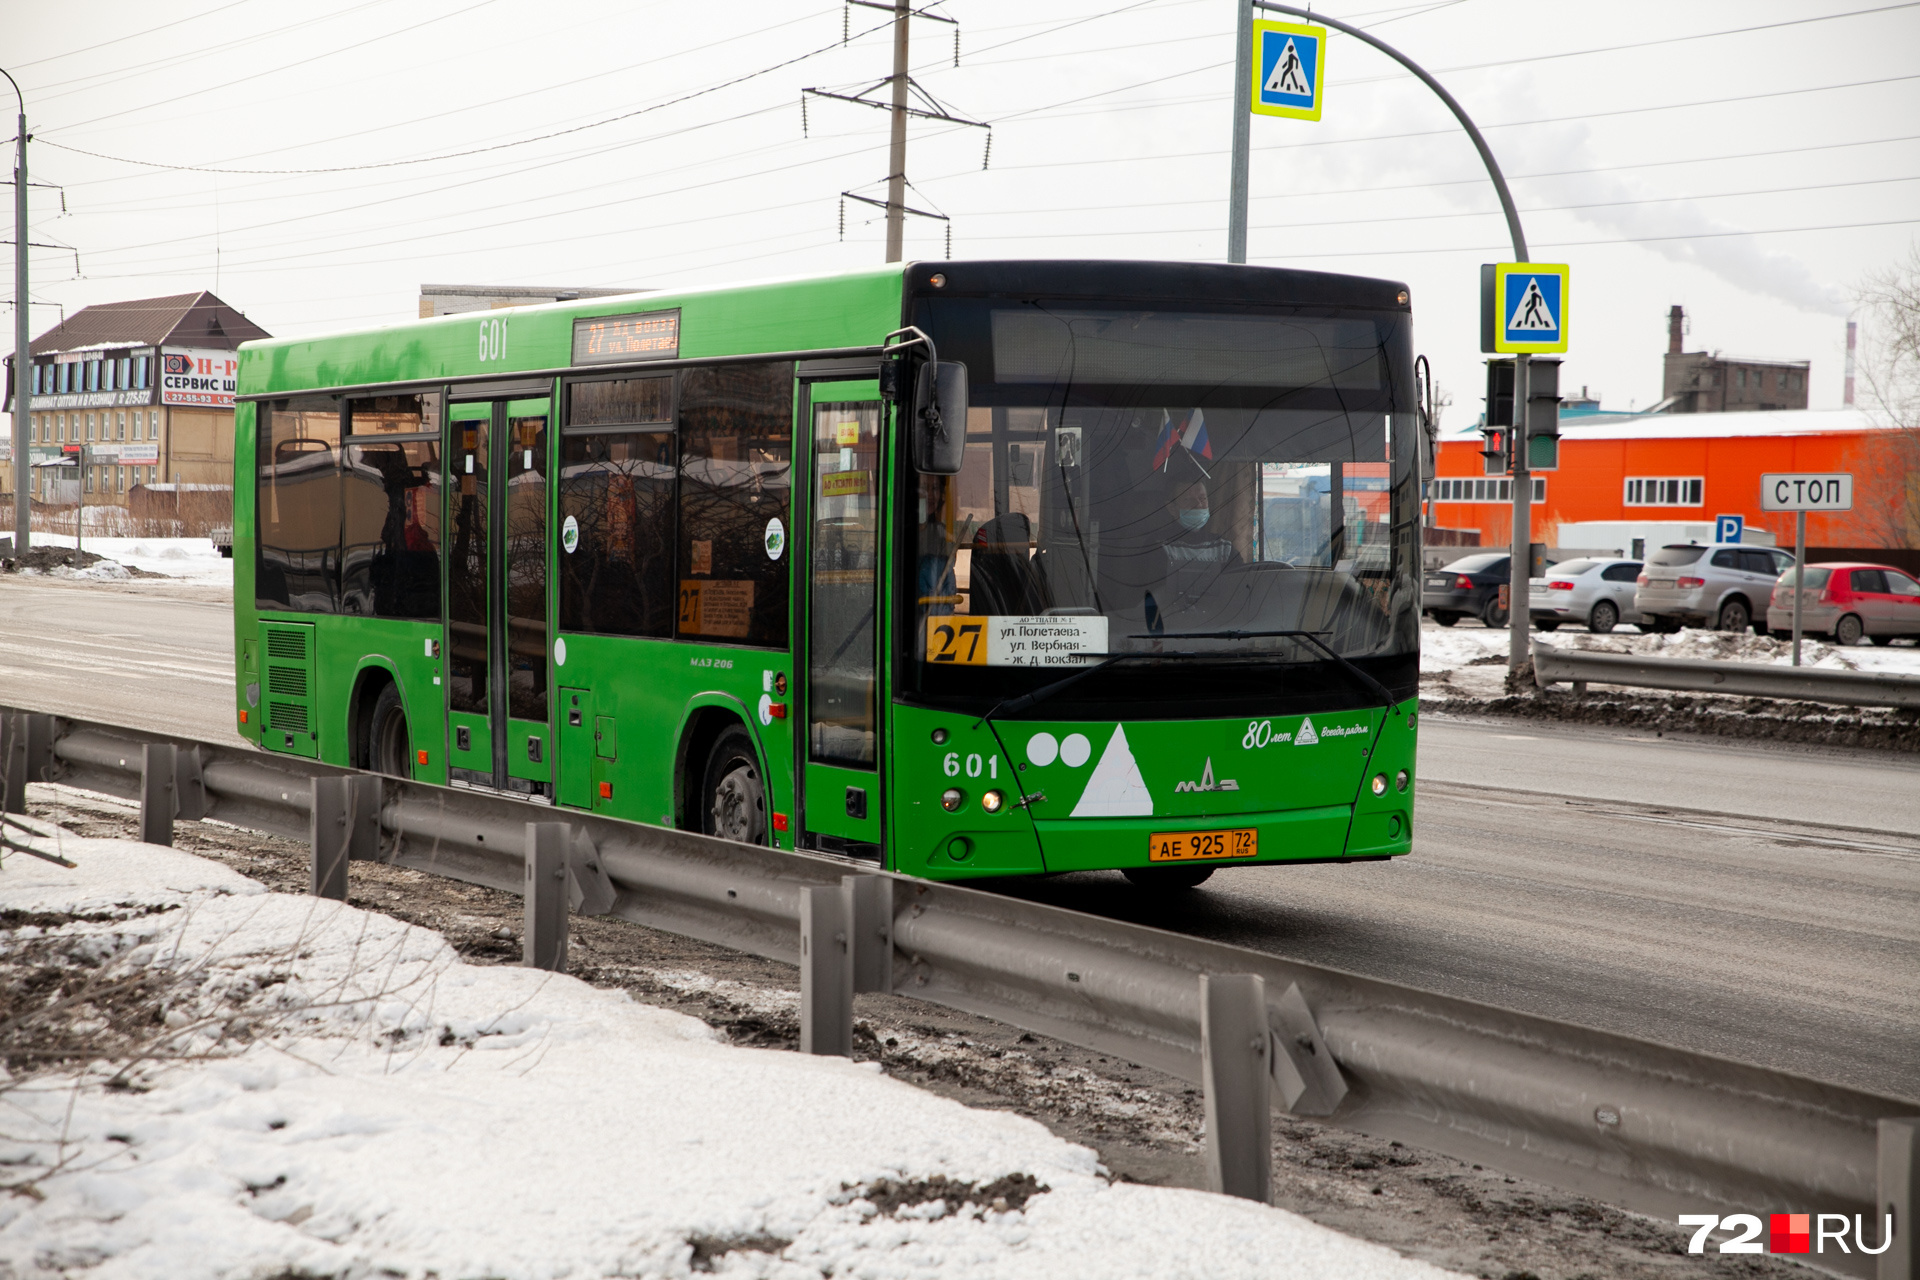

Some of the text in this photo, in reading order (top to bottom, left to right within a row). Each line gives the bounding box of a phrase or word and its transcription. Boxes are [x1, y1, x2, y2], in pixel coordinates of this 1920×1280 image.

[479, 318, 508, 362] 601
[588, 324, 605, 353] 27
[164, 376, 219, 391] СЕРВИС
[172, 393, 212, 403] 27-55-93
[1775, 480, 1840, 504] СТОП
[680, 589, 700, 622] 27
[933, 624, 982, 662] 27
[1000, 628, 1016, 640] ул.
[1019, 626, 1080, 637] Полетаева
[1010, 642, 1026, 653] ул.
[1032, 640, 1079, 653] Вербная
[713, 659, 734, 669] 206
[1045, 655, 1087, 664] вокзал
[1242, 720, 1292, 750] 80 лет
[943, 752, 998, 779] 601
[1191, 835, 1224, 856] 925
[1235, 832, 1251, 847] 72
